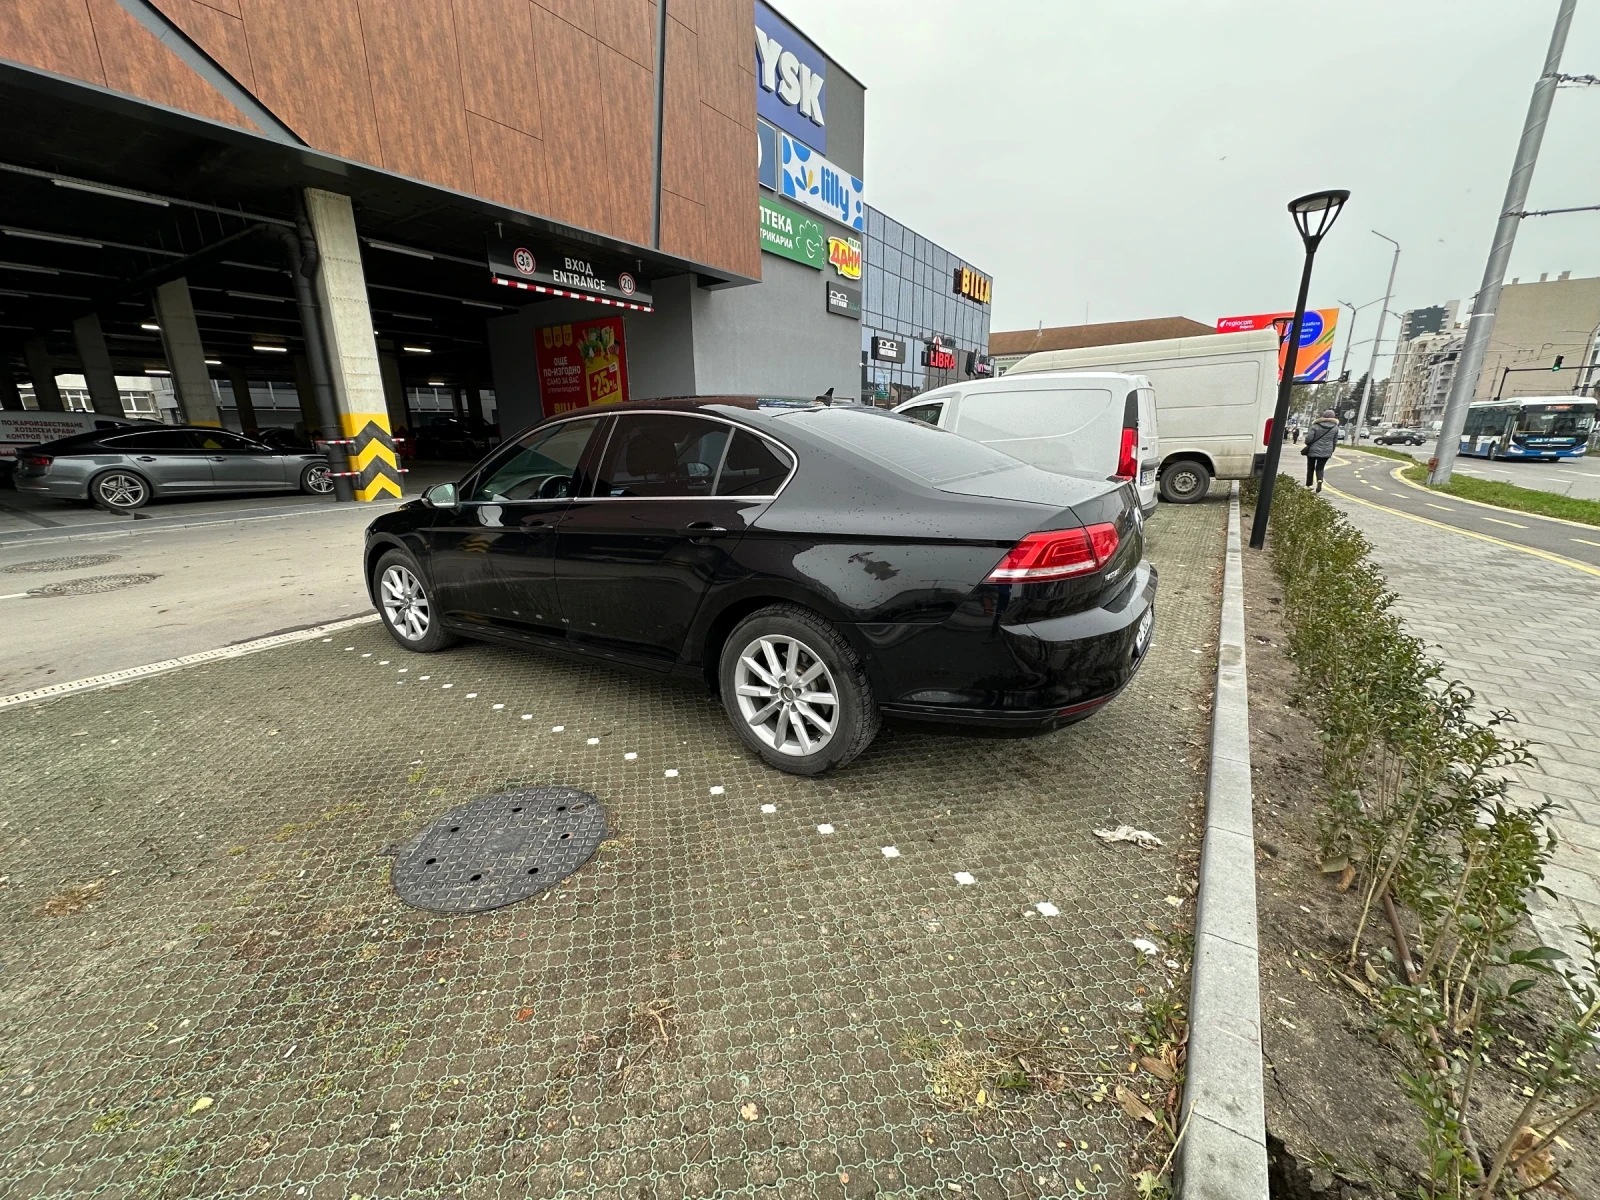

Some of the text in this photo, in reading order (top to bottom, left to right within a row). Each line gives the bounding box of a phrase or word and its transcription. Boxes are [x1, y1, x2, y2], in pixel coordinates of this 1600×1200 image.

[821, 165, 849, 222] lilly
[831, 242, 861, 272] ДАНИ
[564, 257, 594, 277] ВХОД
[552, 269, 607, 292] ENTRANCE
[621, 277, 632, 288] 20
[962, 267, 991, 305] BILLA
[1225, 319, 1253, 327] regiocom
[553, 356, 568, 366] ОЩЕ
[930, 350, 956, 369] LIBRA
[543, 365, 581, 377] ПО-ИЗГОДНО
[547, 377, 561, 386] САМО
[569, 376, 580, 384] ВАС
[554, 401, 578, 414] BILLA
[1, 420, 84, 429] ПОЖАРОИЗВЕСТЯВАНЕ
